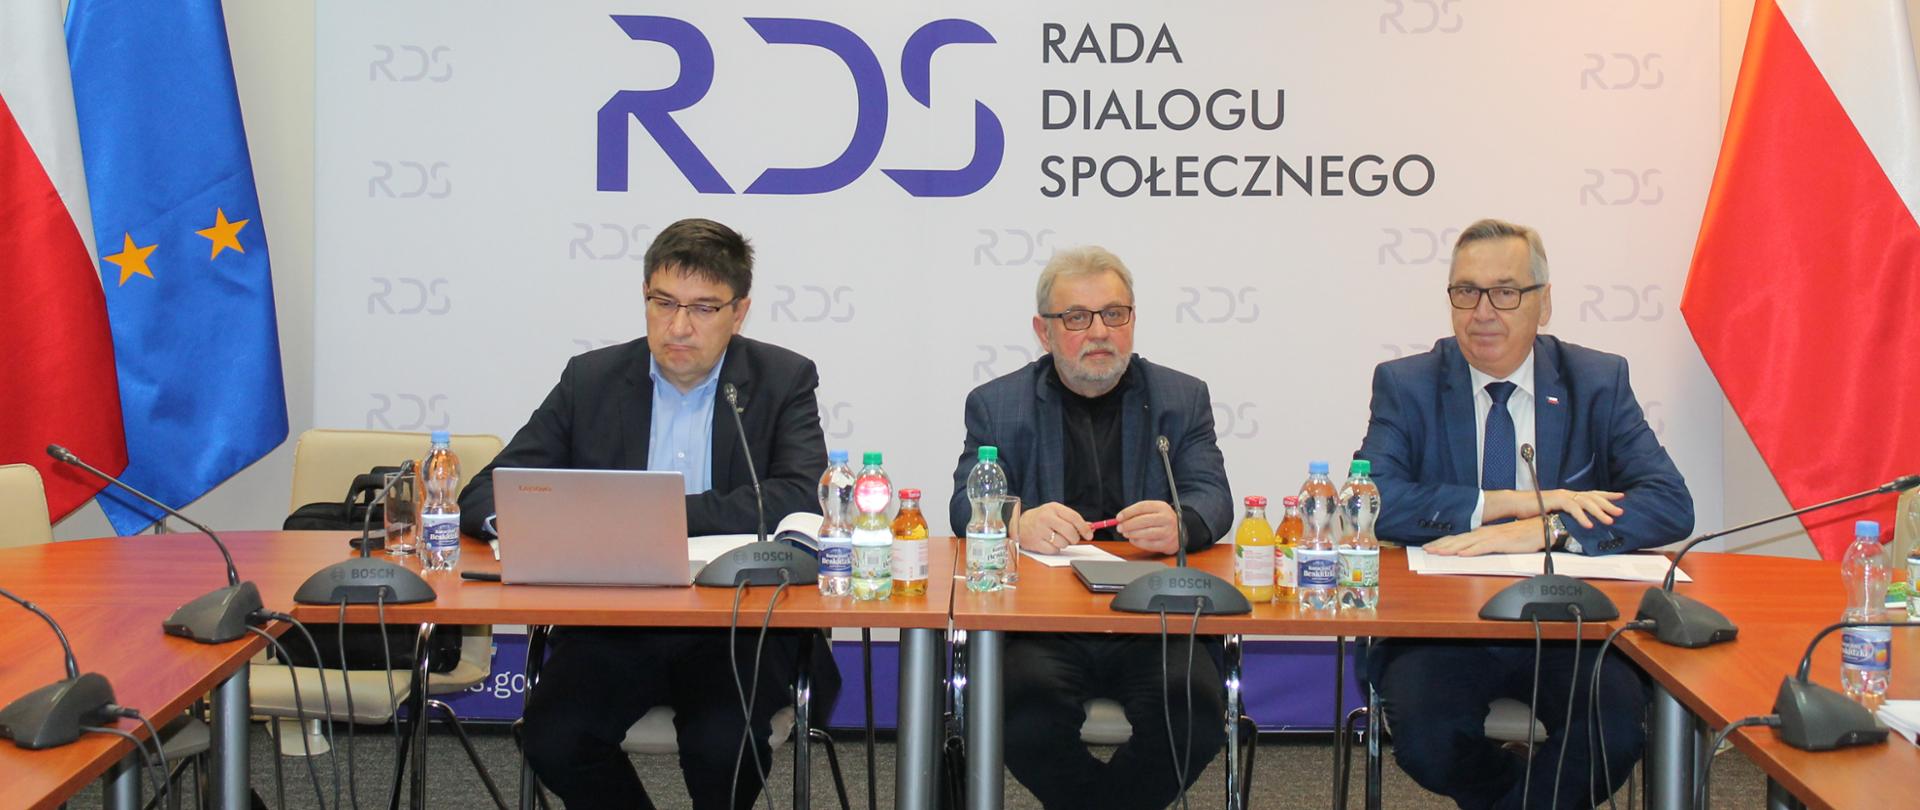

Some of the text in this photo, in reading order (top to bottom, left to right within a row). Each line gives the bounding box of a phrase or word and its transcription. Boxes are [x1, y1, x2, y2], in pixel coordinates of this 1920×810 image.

[1379, 0, 1463, 34] RDS
[1042, 22, 1184, 64] RADA
[369, 44, 453, 83] RDS
[1580, 52, 1664, 90] RDS
[596, 14, 1005, 198] RDS
[1042, 88, 1286, 131] DIALOGU
[368, 161, 452, 199] RDS
[1040, 154, 1436, 198] SPOŁECZNEGO
[1580, 168, 1664, 206] RDS
[367, 277, 451, 315] RDS
[770, 285, 855, 323] RDS
[1175, 286, 1260, 324] RDS
[1579, 284, 1664, 322] RDS
[366, 393, 450, 431] RDS
[1211, 401, 1259, 439] DS
[351, 568, 395, 579] BOSCH
[753, 551, 793, 561] BOSCH
[1168, 577, 1212, 589] BOSCH
[1540, 585, 1583, 596] BOSCH
